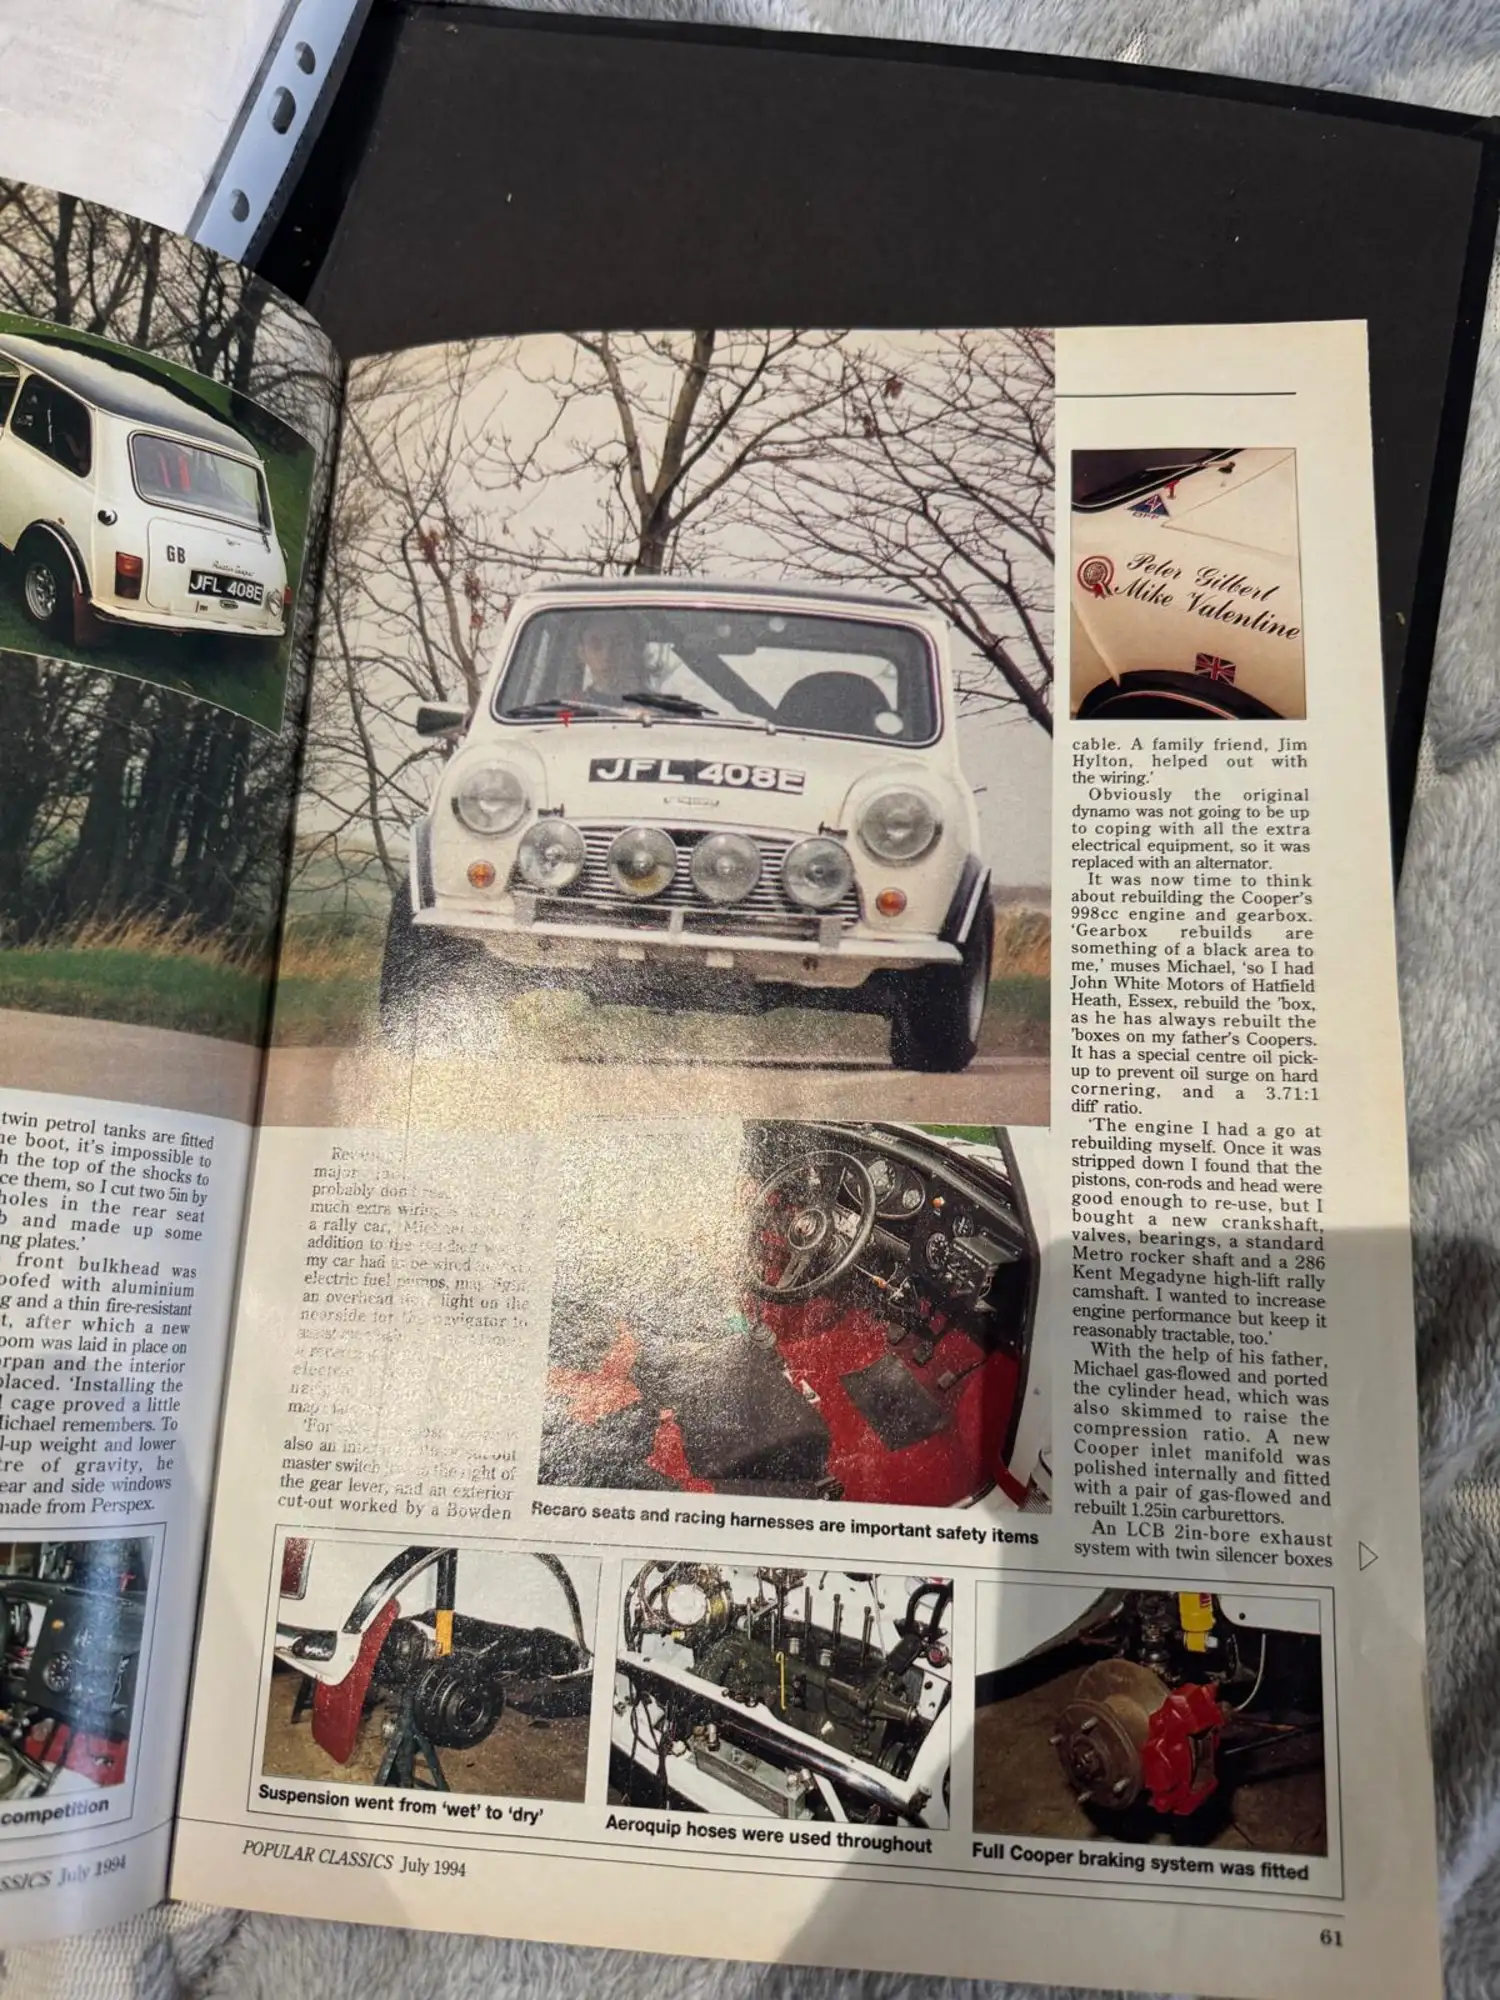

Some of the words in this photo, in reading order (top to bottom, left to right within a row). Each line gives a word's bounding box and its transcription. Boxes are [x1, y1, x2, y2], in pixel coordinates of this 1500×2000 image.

[166, 545, 186, 564] GB
[190, 574, 222, 593] JFL
[226, 580, 263, 601] 408E
[1127, 552, 1182, 580] Peter
[1195, 565, 1280, 602] Gilbert
[1114, 577, 1174, 607] Mike
[1186, 591, 1300, 640] Valentine
[1072, 737, 1121, 751] cable.
[1130, 737, 1144, 751] A
[1152, 737, 1204, 754] family
[1214, 737, 1269, 752] friend,
[1277, 738, 1308, 753] Jim
[1073, 754, 1133, 770] Hylton,
[1152, 753, 1208, 770] helped
[1226, 756, 1253, 768] out
[1271, 754, 1308, 768] with
[596, 759, 685, 782] JFL
[698, 762, 805, 793] 408E
[1088, 787, 1173, 804] Obviously
[1194, 787, 1221, 801] the
[1243, 788, 1309, 805] original
[1071, 838, 1141, 852] electrical
[1147, 839, 1234, 855] equipment,
[1240, 842, 1258, 853] so
[1264, 839, 1275, 853] it
[1280, 843, 1311, 853] was
[1071, 906, 1119, 920] 998cc
[1128, 907, 1186, 924] engine
[1195, 907, 1226, 922] and
[1236, 908, 1313, 925] gearbox.
[1069, 974, 1108, 990] John
[1113, 975, 1161, 991] White
[1167, 977, 1225, 992] Motors
[1230, 978, 1247, 992] of
[1252, 978, 1315, 993] Hatfield
[1071, 1082, 1161, 1100] cornering,
[1182, 1084, 1214, 1099] and
[1235, 1089, 1245, 1100] a
[1266, 1086, 1319, 1101] 3.71:1
[2, 1111, 38, 1128] twin
[45, 1119, 96, 1135] petrol
[104, 1123, 146, 1141] tanks
[152, 1132, 176, 1144] are
[180, 1132, 215, 1150] fitted
[1072, 1207, 1134, 1227] bought
[1148, 1215, 1158, 1226] a
[1172, 1216, 1208, 1227] new
[1222, 1215, 1324, 1234] crankshaft,
[16, 1251, 63, 1270] front
[79, 1255, 160, 1276] bulkhead
[172, 1267, 197, 1279] was
[1072, 1245, 1124, 1262] Metro
[1130, 1248, 1186, 1265] rocker
[1192, 1251, 1235, 1267] shaft
[1241, 1253, 1271, 1269] and
[1279, 1258, 1288, 1269] a
[1294, 1254, 1326, 1271] 286
[1072, 1264, 1113, 1281] Kent
[1119, 1266, 1207, 1287] Megadyne
[1213, 1270, 1280, 1290] high-lift
[1287, 1274, 1326, 1293] rally
[41, 1338, 73, 1350] was
[78, 1335, 108, 1352] laid
[112, 1337, 127, 1353] in
[131, 1338, 169, 1356] place
[171, 1343, 187, 1354] on
[10, 1398, 56, 1414] cage
[62, 1396, 125, 1415] proved
[132, 1401, 141, 1413] a
[147, 1397, 181, 1413] little
[62, 1416, 156, 1433] remembers.
[161, 1416, 178, 1431] To
[1073, 1423, 1188, 1440] compression
[1203, 1426, 1250, 1443] ratio.
[1265, 1428, 1279, 1445] A
[1293, 1434, 1330, 1446] new
[40, 1436, 97, 1456] weight
[104, 1436, 133, 1452] and
[139, 1436, 177, 1452] lower
[282, 1455, 331, 1471] master
[46, 1498, 86, 1515] from
[91, 1497, 155, 1515] Perspex.
[278, 1494, 333, 1510] cut-out
[340, 1497, 398, 1514] worked
[406, 1499, 424, 1519] by
[431, 1506, 439, 1516] a
[447, 1502, 512, 1521] Bowden
[1074, 1498, 1127, 1516] rebuilt
[1132, 1502, 1177, 1519] 1.25in
[1181, 1505, 1285, 1525] carburettors.
[532, 1501, 587, 1518] Recaro
[592, 1506, 636, 1521] seats
[640, 1508, 670, 1522] and
[675, 1510, 726, 1529] racing
[730, 1512, 815, 1531] harnesses
[819, 1520, 846, 1533] are
[851, 1519, 932, 1539] important
[936, 1525, 987, 1545] safety
[992, 1528, 1039, 1545] items
[1091, 1519, 1117, 1536] An
[1127, 1521, 1165, 1538] LCB
[1174, 1524, 1250, 1543] 2in-bore
[1259, 1529, 1332, 1548] exhaust
[1074, 1541, 1131, 1558] system
[1136, 1543, 1170, 1559] with
[1176, 1545, 1210, 1561] twin
[1216, 1546, 1279, 1565] silencer
[1284, 1549, 1333, 1568] boxes
[0, 1799, 109, 1826] competition
[258, 1784, 350, 1807] Suspension
[354, 1797, 394, 1811] went
[399, 1798, 437, 1815] from
[485, 1805, 503, 1821] to
[605, 1814, 682, 1838] Aeroquip
[686, 1821, 737, 1840] hoses
[742, 1828, 784, 1844] were
[789, 1831, 831, 1847] used
[836, 1832, 932, 1854] throughout
[57, 1865, 90, 1887] July
[95, 1853, 127, 1877] 1994
[242, 1839, 316, 1862] POPULAR
[318, 1848, 395, 1870] CLASSICS
[399, 1855, 430, 1877] July
[434, 1860, 466, 1877] 1994
[972, 1841, 1005, 1860] Full
[1010, 1844, 1074, 1867] Cooper
[1079, 1849, 1146, 1873] braking
[1150, 1857, 1214, 1874] system
[1220, 1862, 1256, 1877] was
[1260, 1862, 1309, 1881] fitted
[1320, 1929, 1343, 1947] 61
